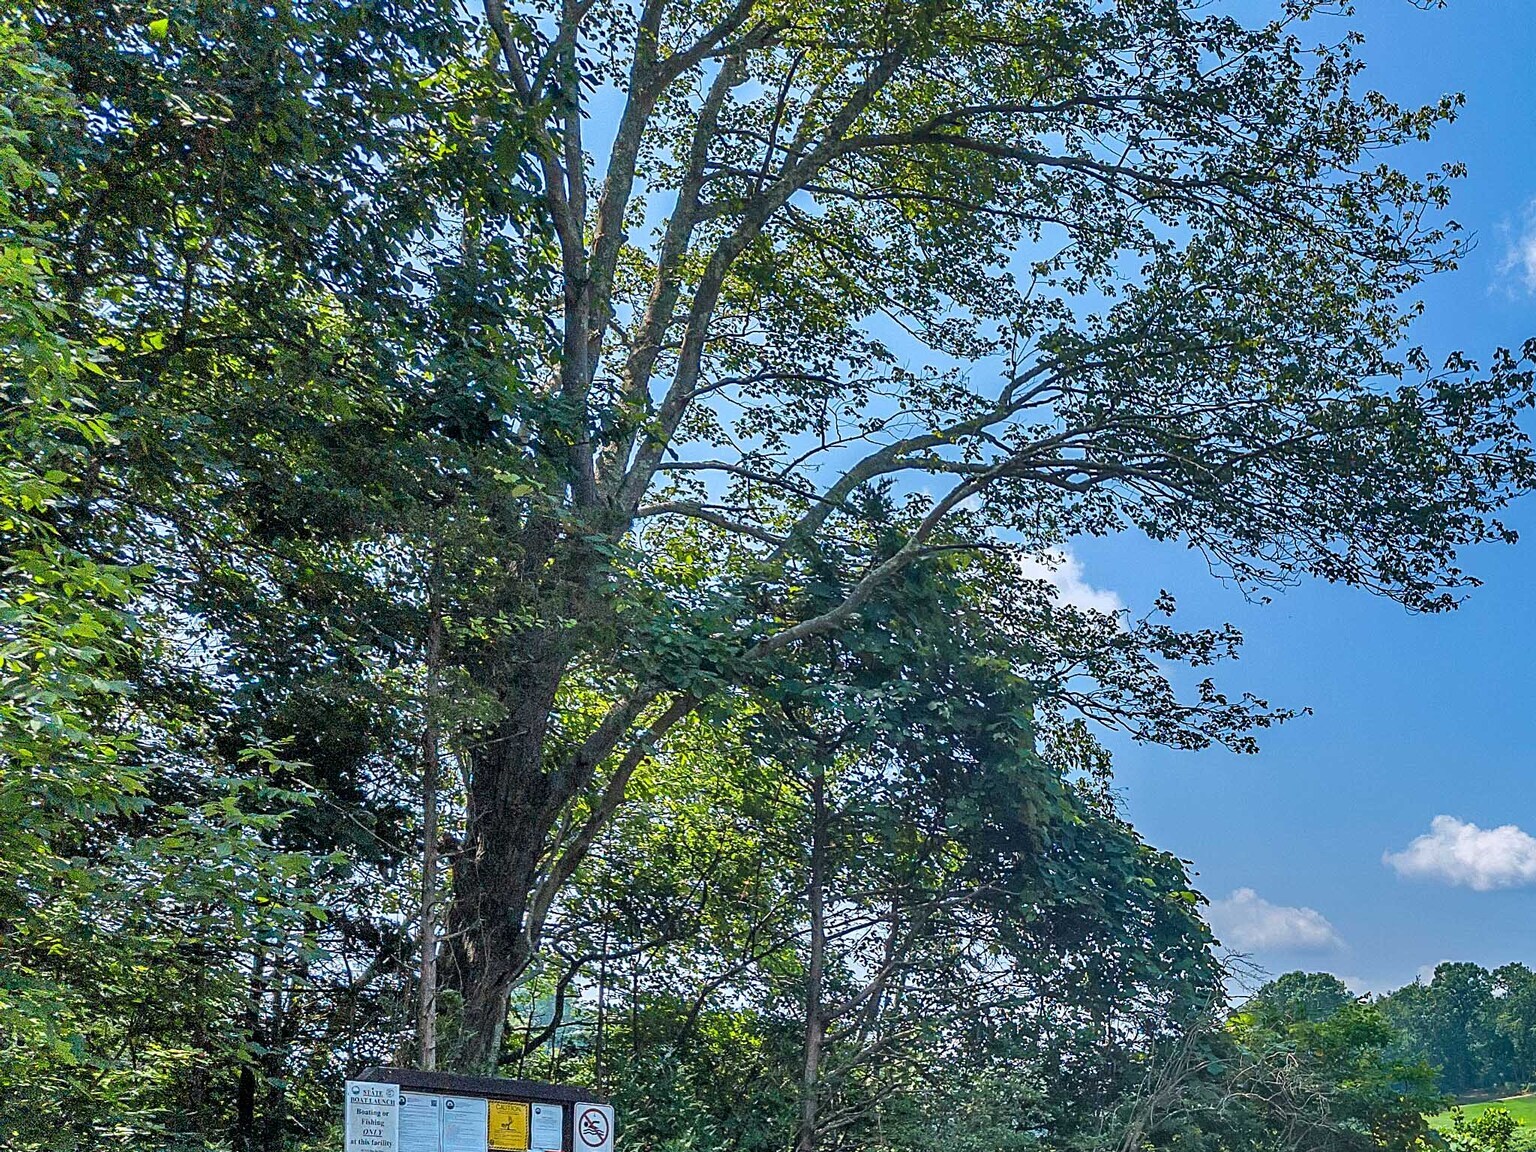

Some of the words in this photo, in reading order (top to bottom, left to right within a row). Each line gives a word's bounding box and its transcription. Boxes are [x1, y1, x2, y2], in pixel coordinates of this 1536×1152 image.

[370, 1098, 395, 1106] LAUNCH
[356, 1108, 381, 1117] Boating
[361, 1118, 385, 1127] Fishing
[363, 1128, 383, 1136] ONLY
[371, 1139, 392, 1148] facility
